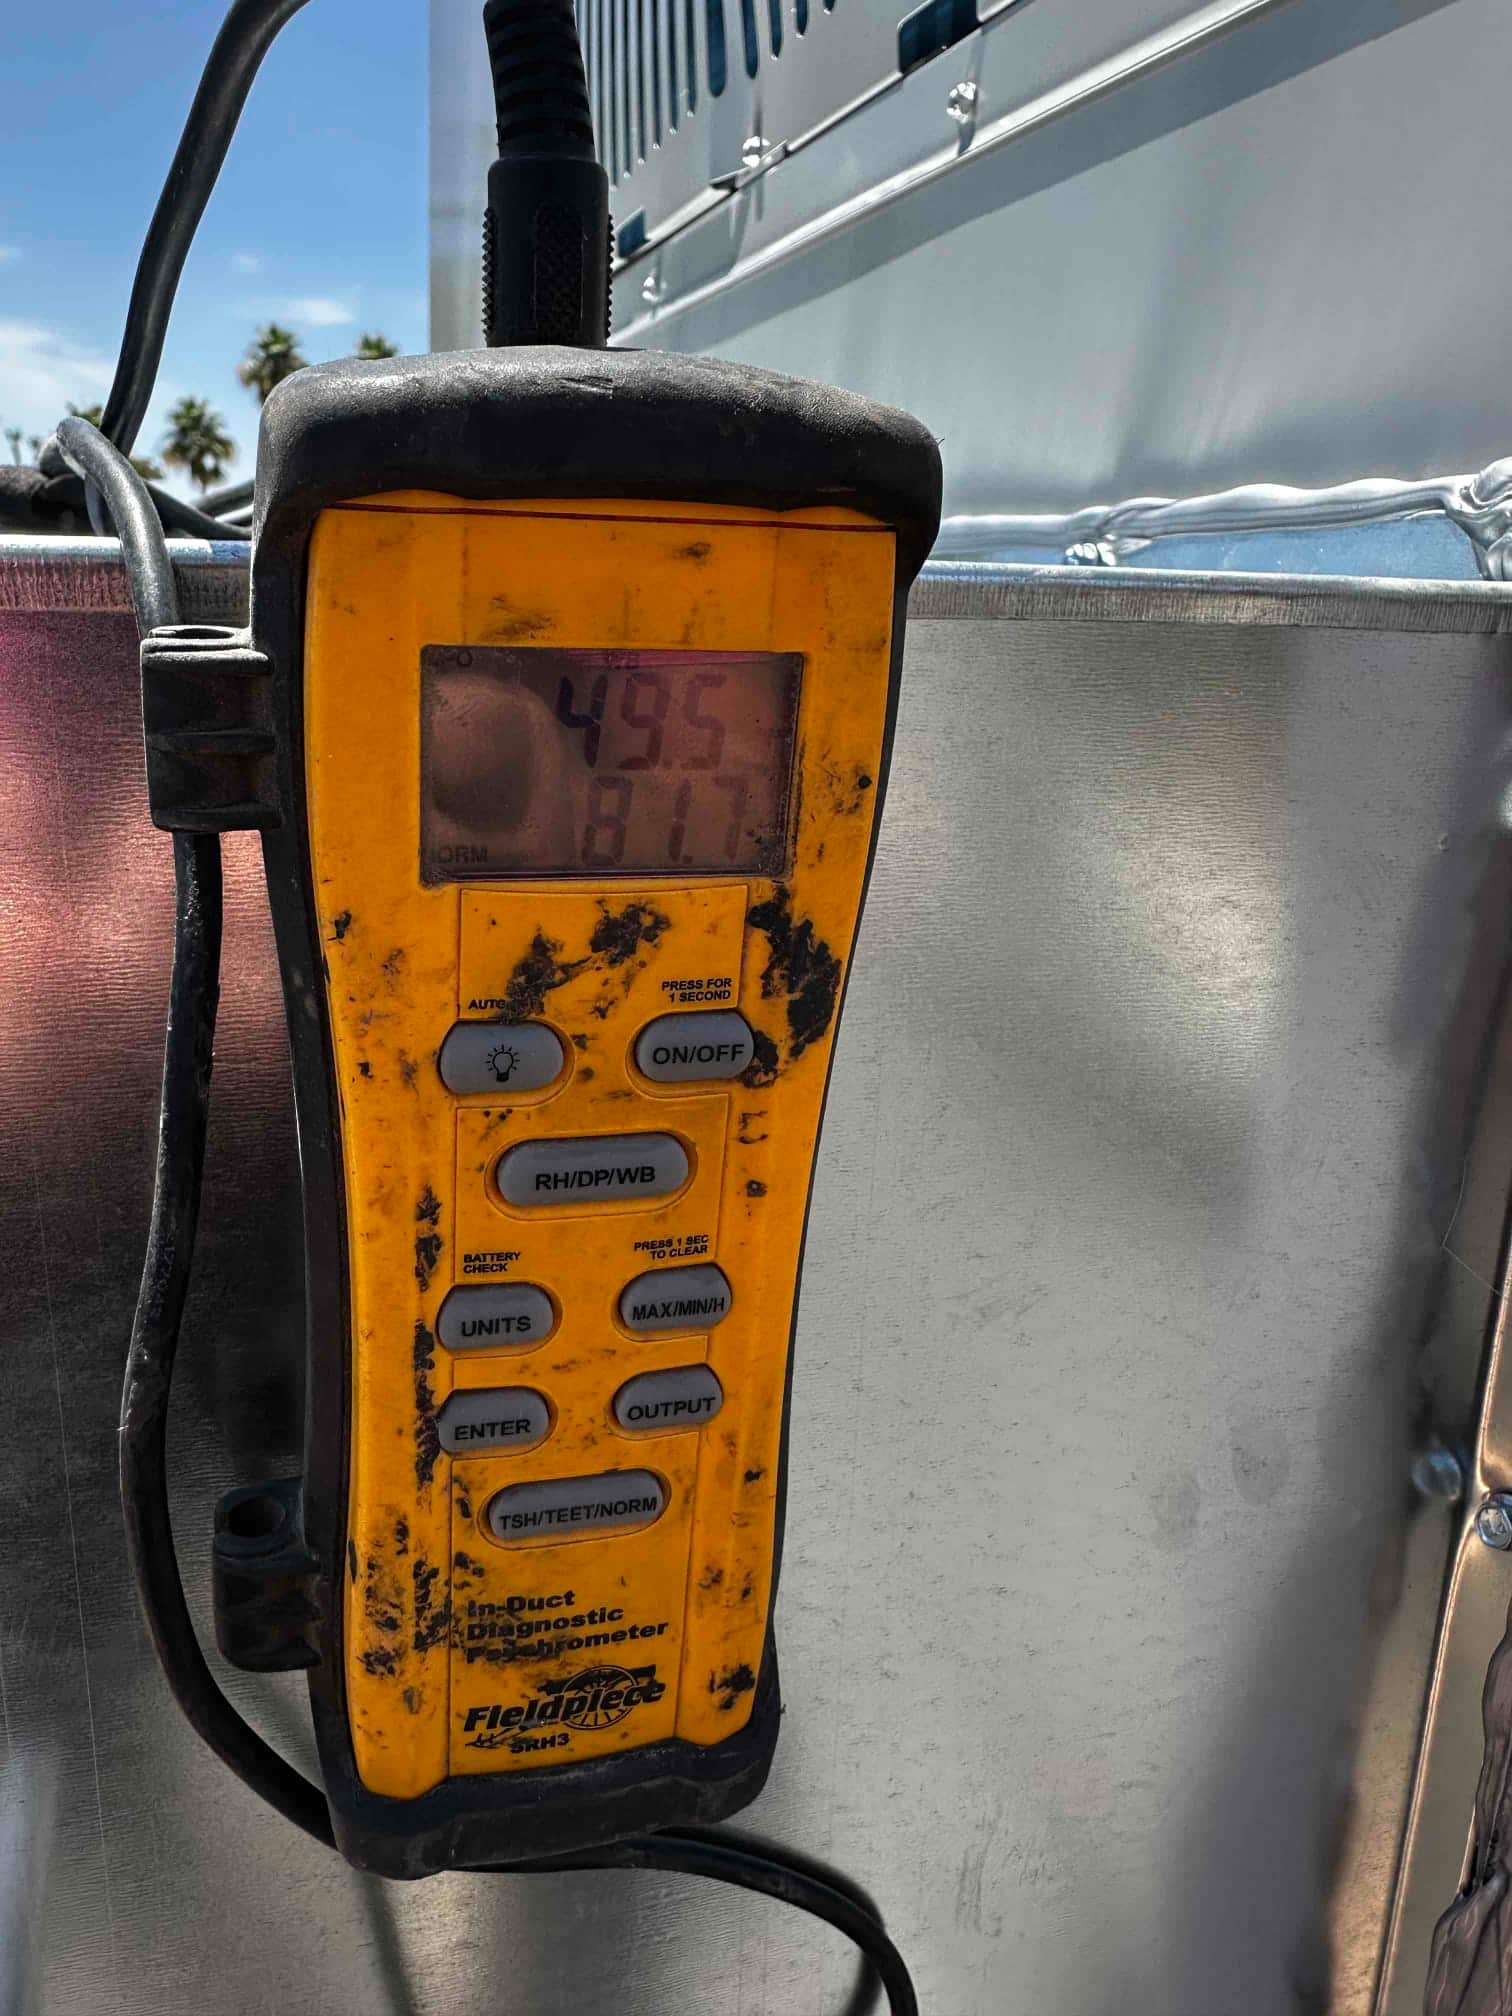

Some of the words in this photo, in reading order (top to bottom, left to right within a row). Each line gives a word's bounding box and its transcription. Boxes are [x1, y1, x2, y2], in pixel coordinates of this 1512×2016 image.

[580, 775, 747, 865] 81.7
[661, 979, 703, 991] PRESS
[706, 977, 732, 989] FOR
[669, 992, 676, 1003] 1
[679, 989, 731, 1002] SECOND
[652, 1043, 745, 1065] ON/OFF
[535, 1165, 656, 1190] RH/DP/WB
[634, 1239, 673, 1251] PRESS
[676, 1238, 682, 1248] 1
[686, 1234, 709, 1247] SEC
[650, 1248, 666, 1260] TO
[669, 1245, 709, 1258] CLEAR
[463, 1251, 521, 1263] BATTERY
[463, 1263, 508, 1274] CHECK
[632, 1297, 725, 1321] MAX/MIN/H
[461, 1316, 532, 1337] UNITS
[627, 1397, 716, 1421] OUTPUT
[454, 1419, 531, 1440] ENTER
[500, 1497, 658, 1530] TSH/TEET/NORM
[466, 1590, 576, 1618] In-Duct
[466, 1607, 624, 1640] Diagnostic
[463, 1678, 668, 1732] Fieldpiece
